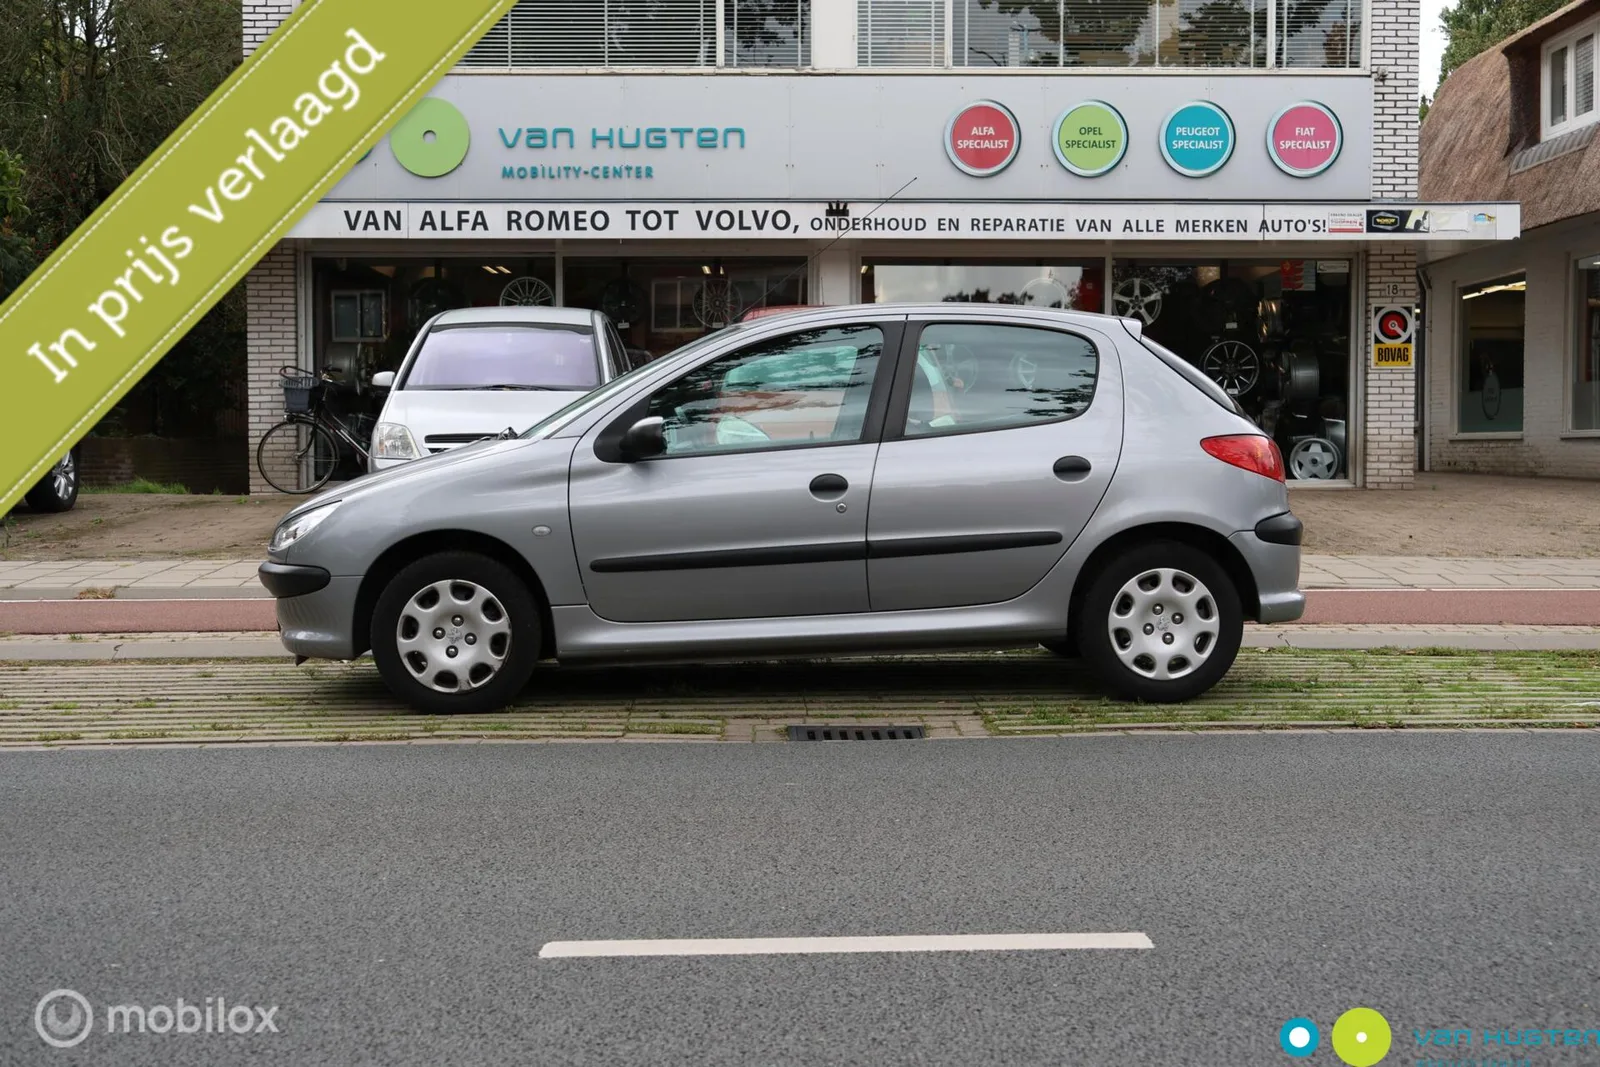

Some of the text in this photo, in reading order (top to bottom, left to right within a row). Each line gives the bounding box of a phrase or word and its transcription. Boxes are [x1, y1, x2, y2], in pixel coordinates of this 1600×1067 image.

[971, 126, 995, 136] ALFA
[1079, 126, 1103, 136] OPEL
[1175, 126, 1221, 136] PEUGEOT
[1294, 126, 1316, 136] FIAT
[957, 139, 1009, 150] SPECIALIST
[1065, 139, 1116, 150] SPECIALIST
[1172, 139, 1224, 150] SPECIALIST
[1279, 139, 1331, 150] SPECIALIST
[501, 165, 655, 179] MOBILITY-CENTER
[344, 209, 1327, 234] VAN ALFA ROMEO TOT VOLVO, ONDERHOUD EN REPARATIE VAN ALLE MERKEN AUTO'S!
[1386, 283, 1399, 295] 18
[1377, 347, 1409, 362] BOVAG
